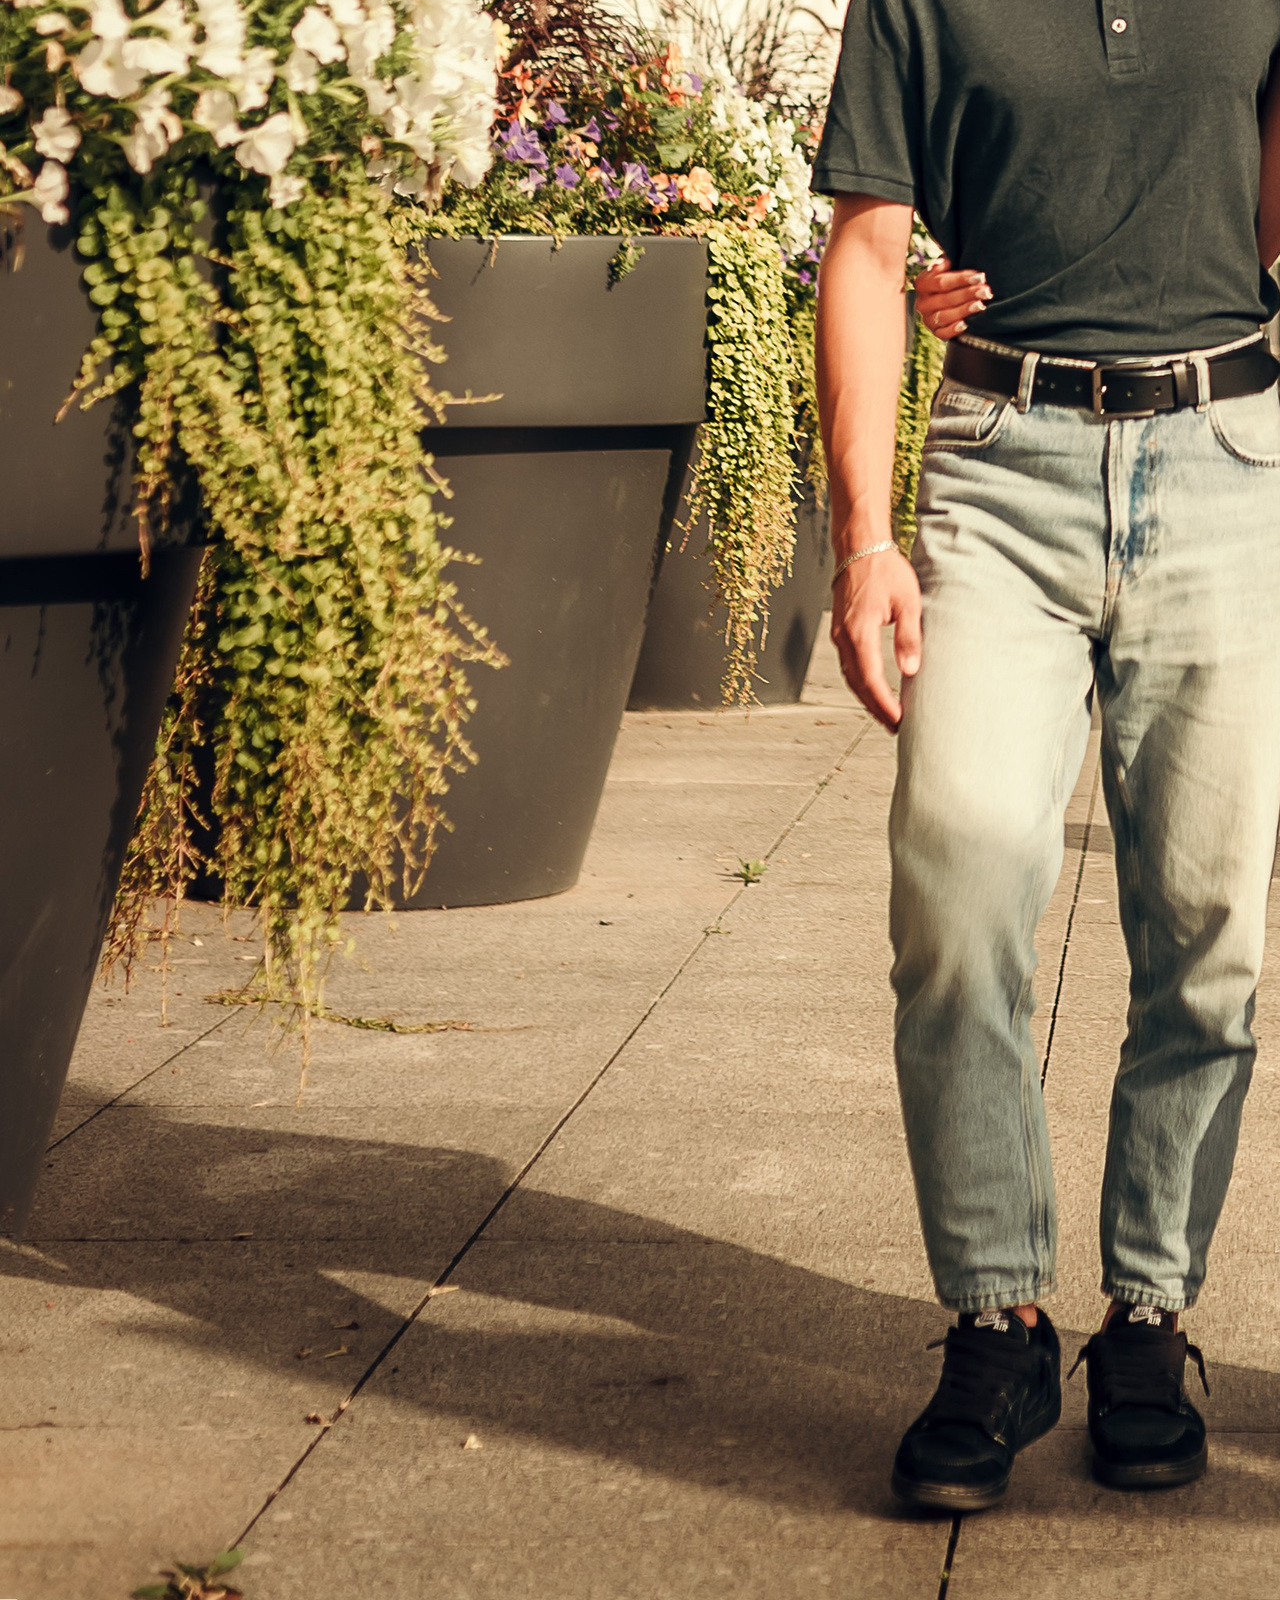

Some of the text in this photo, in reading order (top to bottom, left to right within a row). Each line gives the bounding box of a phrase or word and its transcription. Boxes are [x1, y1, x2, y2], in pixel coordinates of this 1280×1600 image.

[979, 1311, 1002, 1321] NIKE
[1133, 1305, 1155, 1316] NIKE
[993, 1320, 1009, 1332] AIR
[1147, 1315, 1161, 1327] AIR
